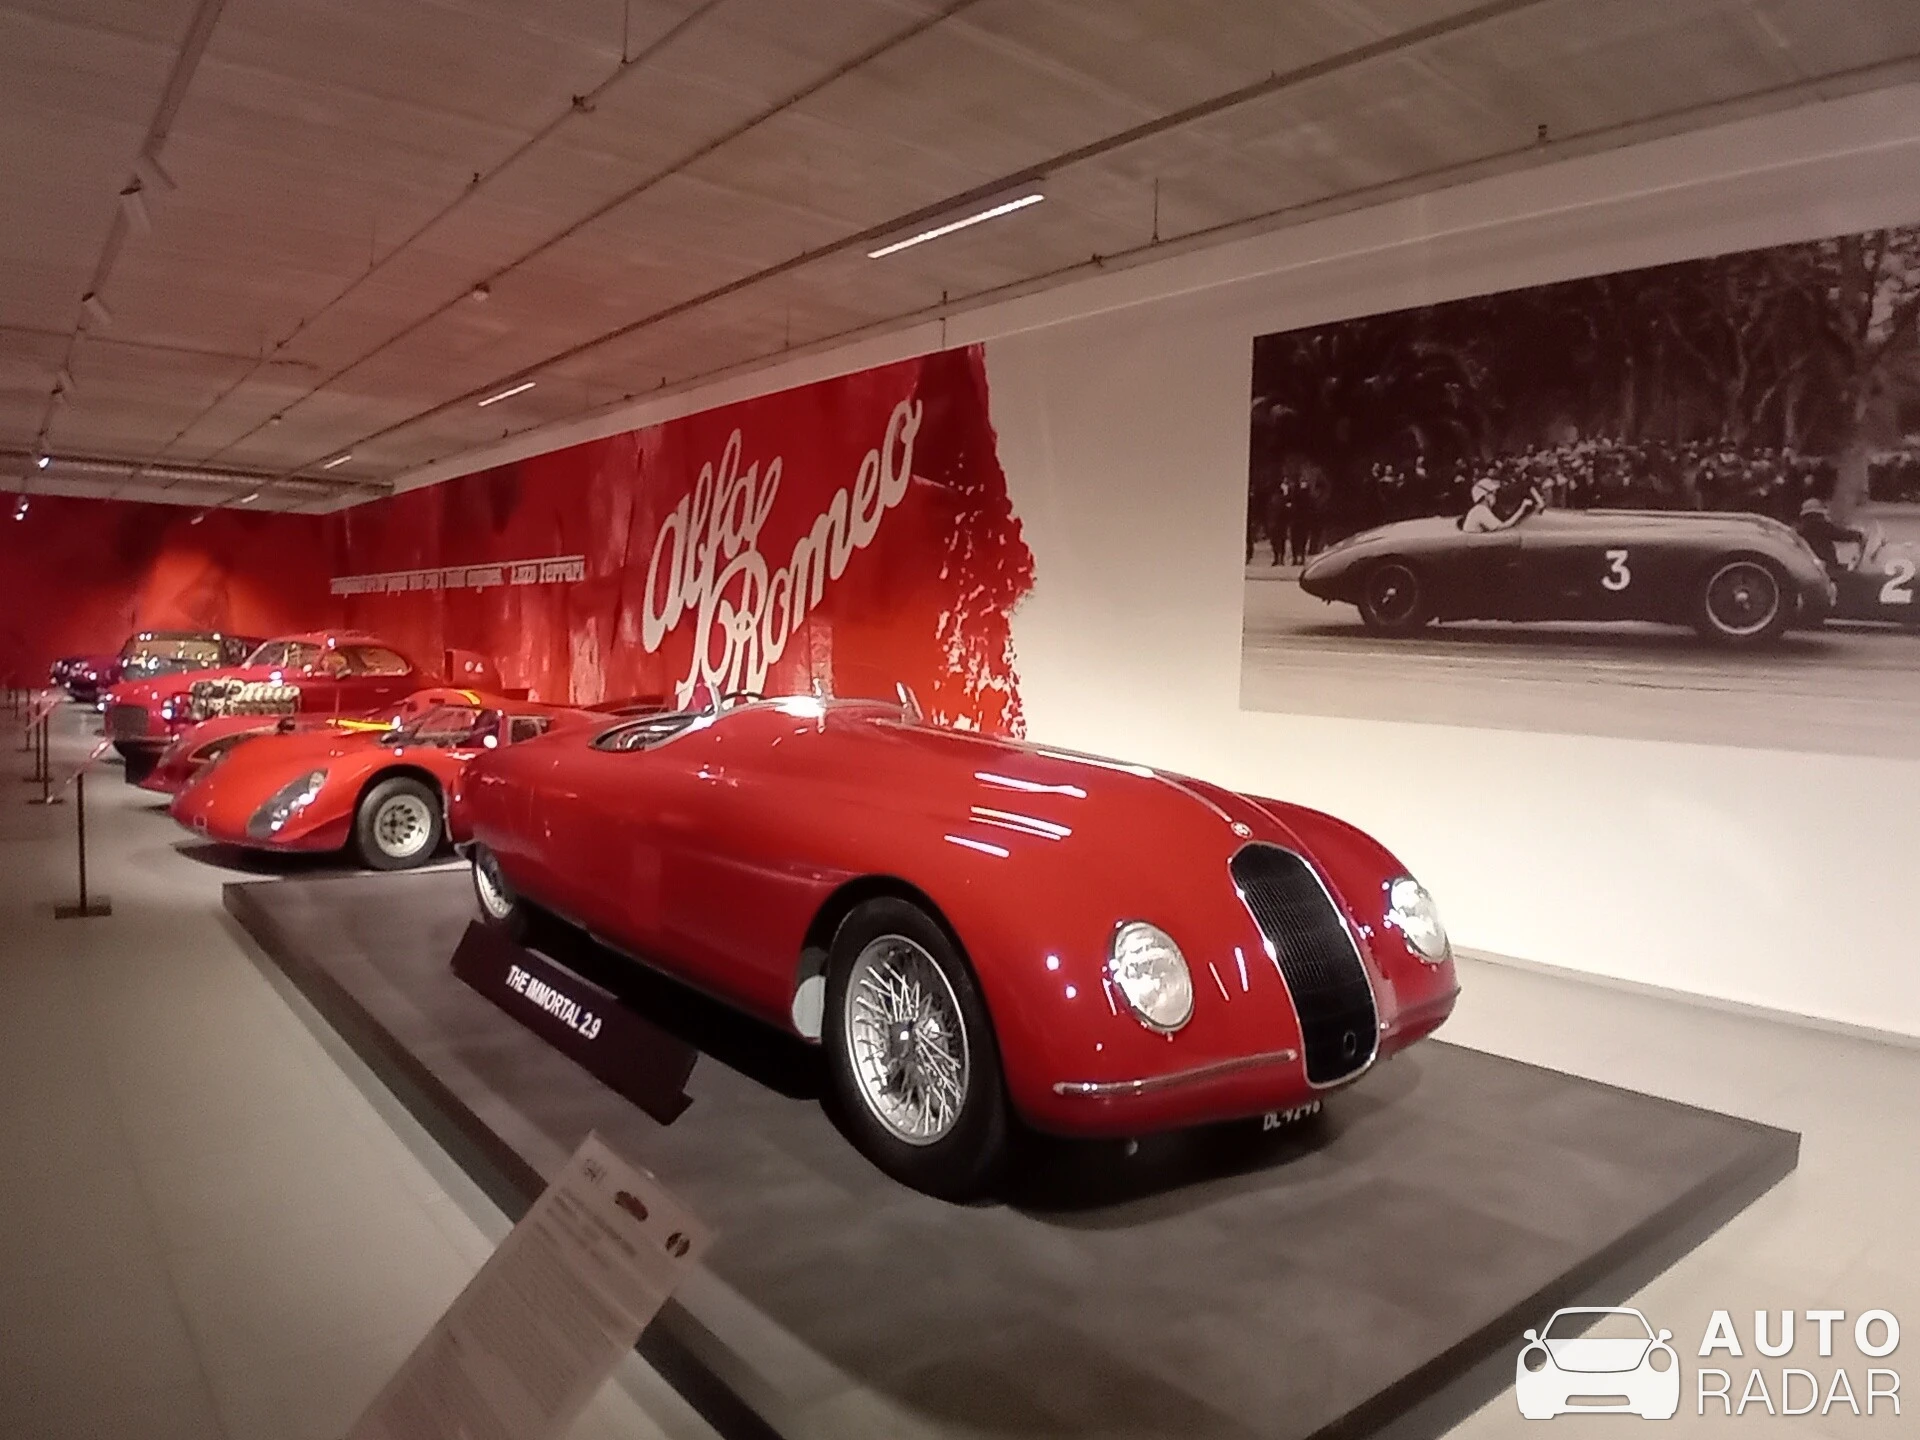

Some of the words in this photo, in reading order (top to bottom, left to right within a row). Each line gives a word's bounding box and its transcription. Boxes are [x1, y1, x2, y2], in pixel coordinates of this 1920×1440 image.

[676, 399, 923, 709] Romeo
[1601, 549, 1632, 591] 3
[1879, 558, 1917, 604] 2
[505, 964, 531, 994] THE
[524, 976, 583, 1029] IMMORTAL
[578, 1012, 603, 1040] 2.9
